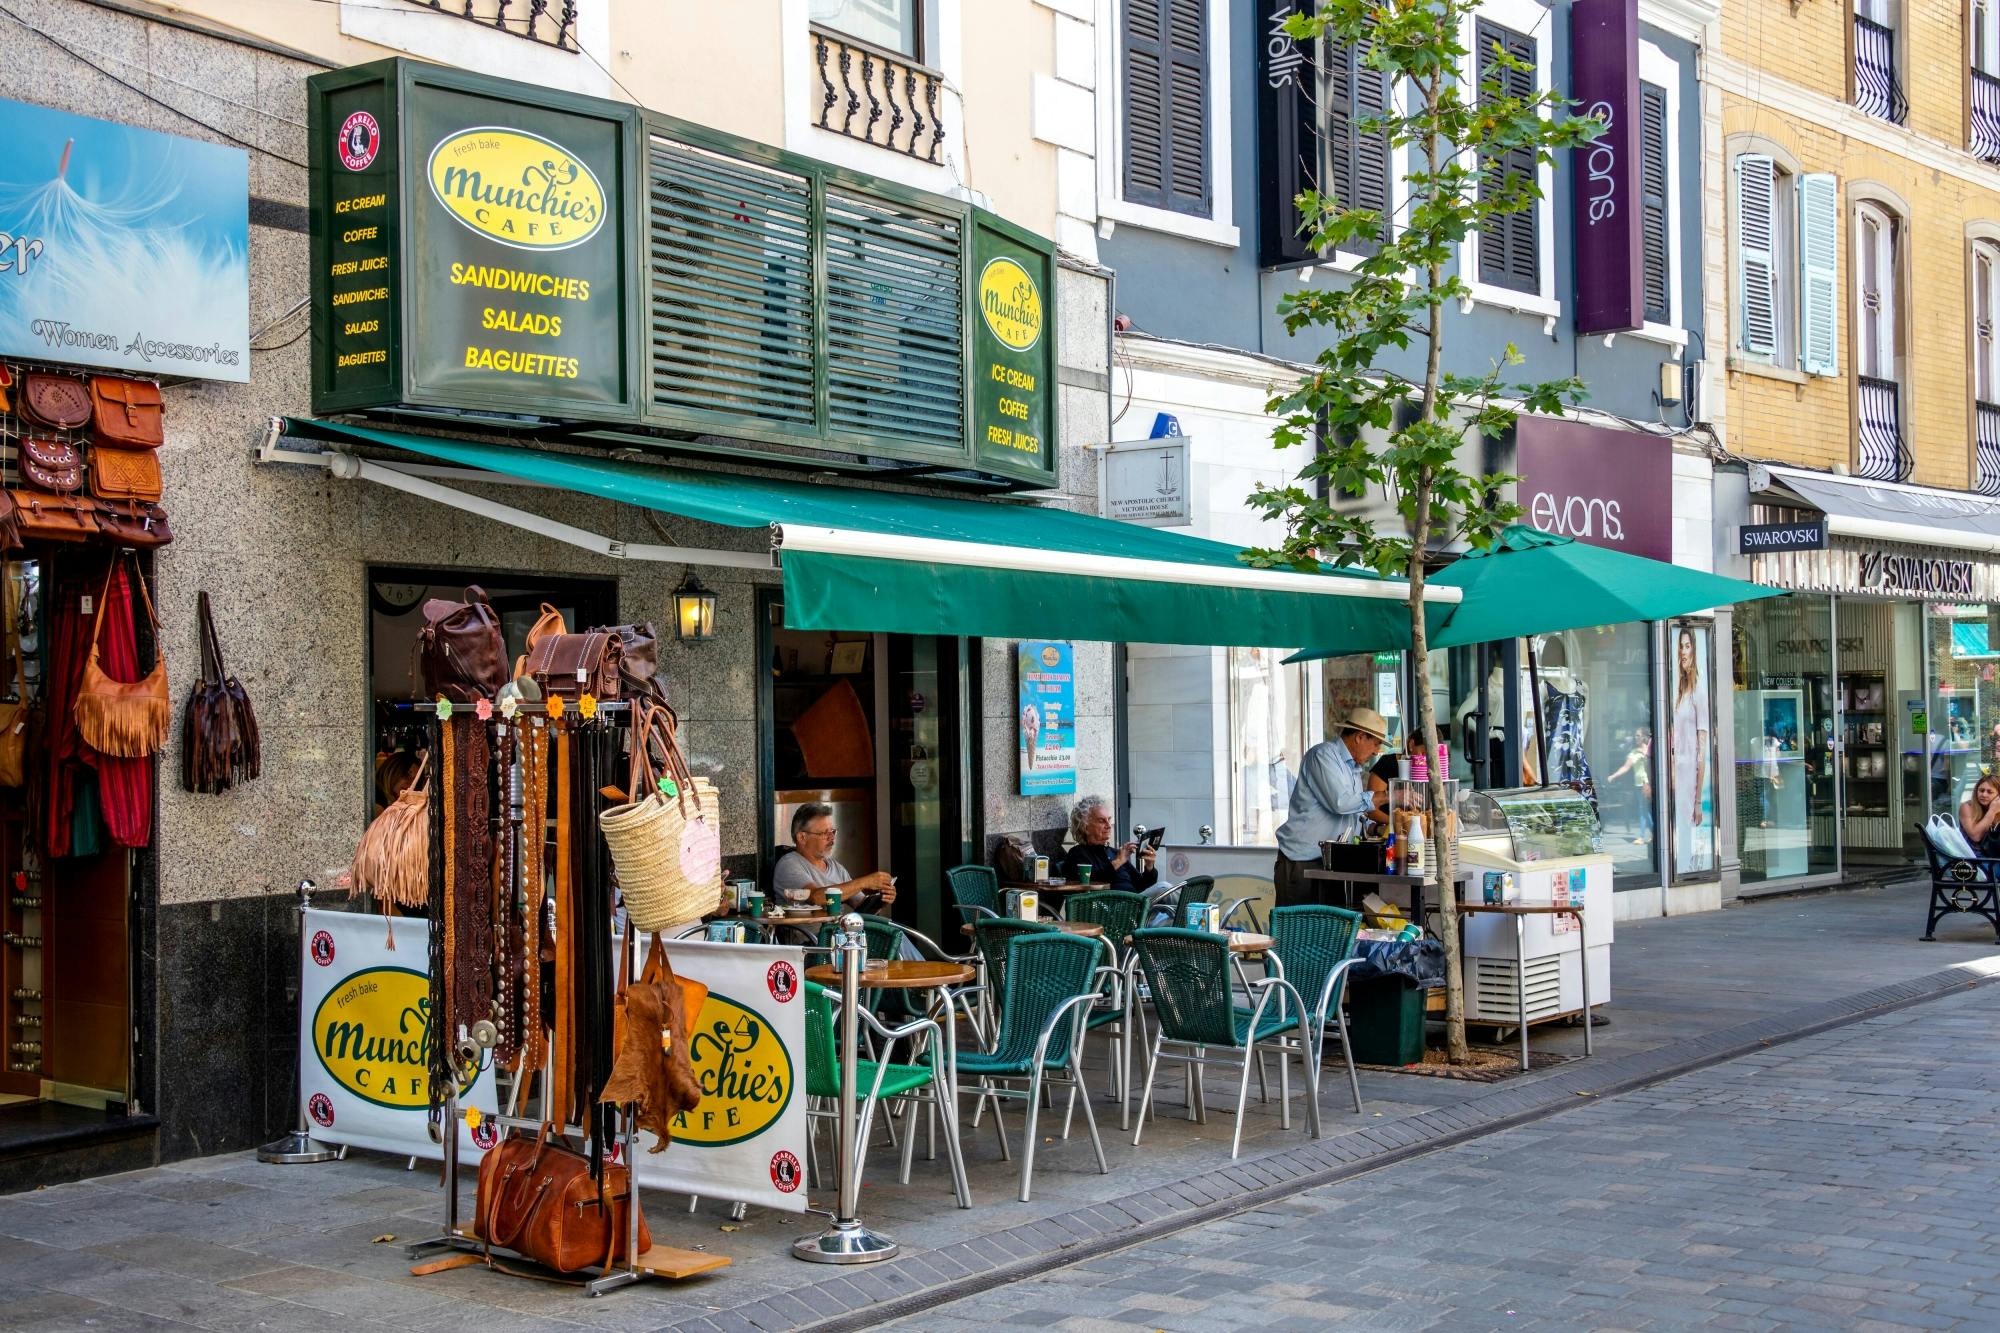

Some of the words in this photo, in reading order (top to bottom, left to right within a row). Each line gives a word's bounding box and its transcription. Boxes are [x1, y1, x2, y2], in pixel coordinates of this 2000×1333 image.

[341, 115, 377, 143] SACARELLO
[453, 140, 477, 157] fresh
[479, 138, 501, 150] bake
[345, 152, 372, 168] COFFEE
[335, 200, 351, 213] ICE
[352, 194, 386, 210] CREAM
[443, 166, 597, 223] Munchie's
[475, 208, 562, 236] CAFE
[343, 227, 378, 243] COFFEE
[331, 261, 358, 276] FRESH
[450, 262, 590, 301] SANDWICHES
[985, 288, 1039, 329] Munchie's
[345, 320, 379, 335] SALADS
[482, 307, 562, 337] SALADS
[996, 321, 1029, 340] CAFE
[31, 319, 119, 352] Women
[123, 332, 240, 366] Accessories
[338, 350, 387, 367] BAGUETTES
[464, 346, 579, 379] BAGUETTES
[991, 364, 1006, 382] ICE
[1007, 370, 1035, 392] CREAM
[999, 398, 1029, 420] COFFEE
[987, 425, 1012, 447] FRESH
[1013, 432, 1039, 454] JUICES
[1531, 492, 1625, 540] evans.
[1744, 529, 1818, 546] SWAROVSKI
[1777, 638, 1865, 654] SWAROSKI
[1762, 677, 1775, 686] NEW
[1775, 677, 1805, 686] COLLECTION
[768, 963, 796, 981] SACARELLO
[336, 987, 358, 1009] fresh
[359, 981, 378, 996] bake
[772, 990, 792, 1001] COFFEE
[325, 1020, 430, 1067] Munch
[355, 1068, 422, 1095] CAF
[699, 1043, 783, 1103] chie's
[672, 1106, 741, 1130] AFE
[475, 1137, 494, 1149] COFFEE
[771, 1152, 800, 1172] SACARELLO
[774, 1179, 795, 1191] COFFEE
